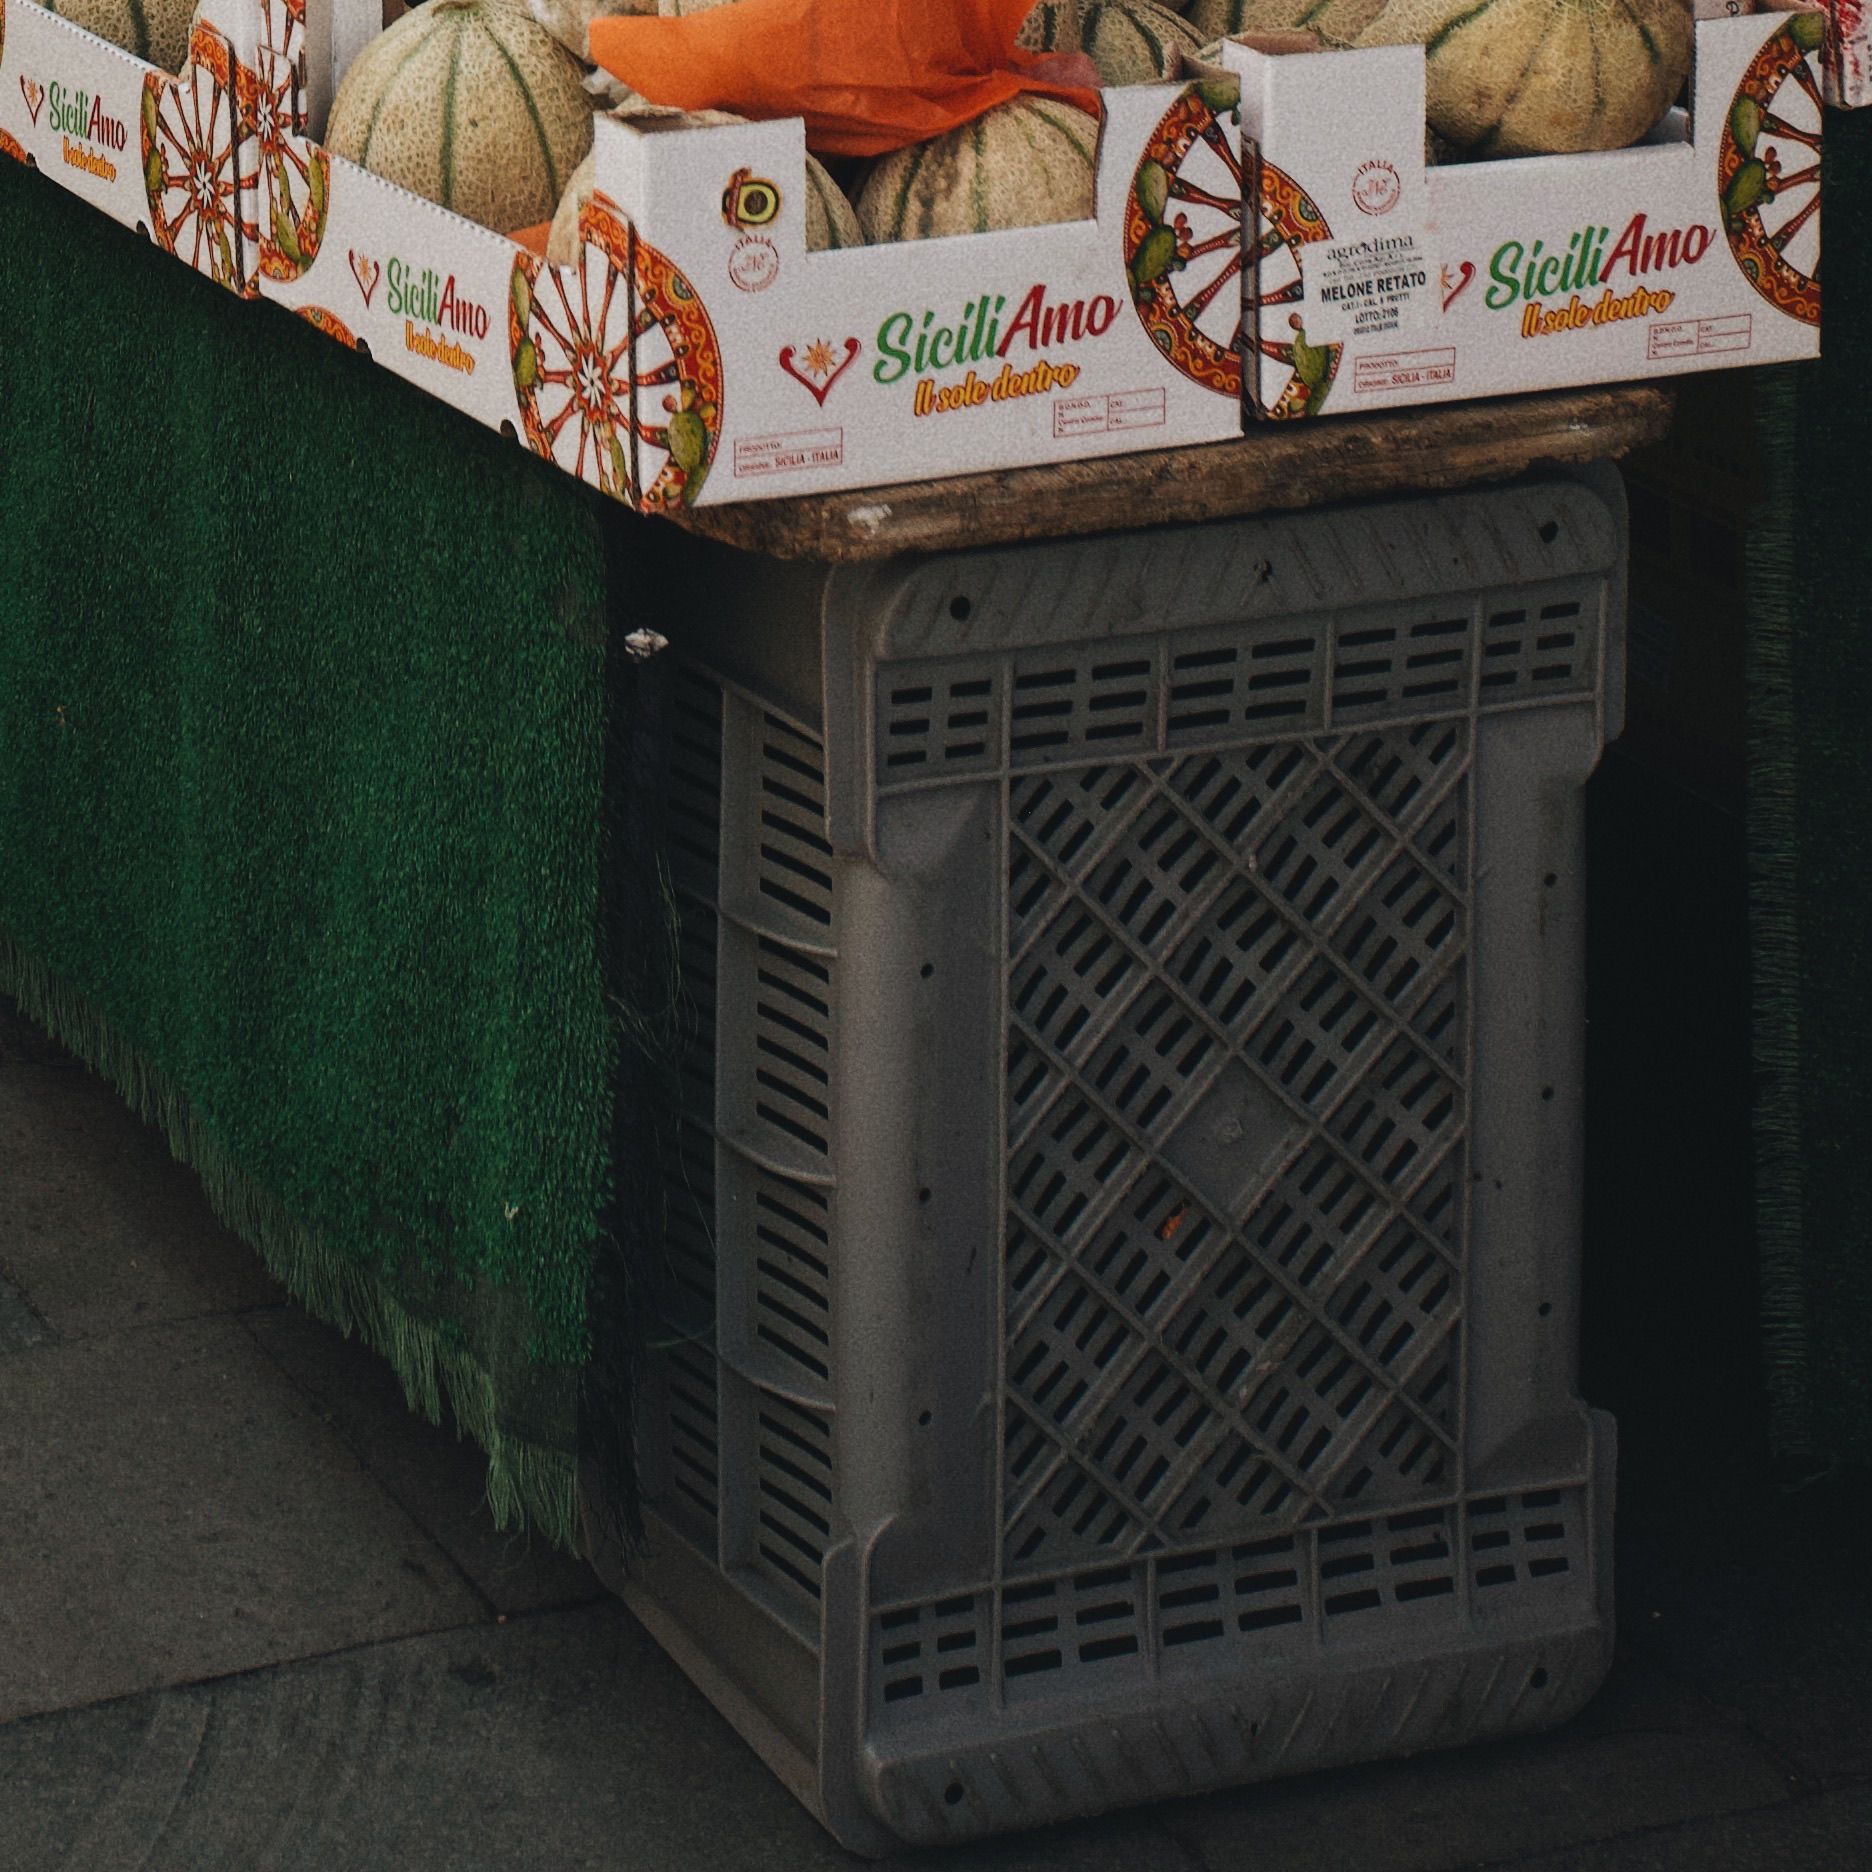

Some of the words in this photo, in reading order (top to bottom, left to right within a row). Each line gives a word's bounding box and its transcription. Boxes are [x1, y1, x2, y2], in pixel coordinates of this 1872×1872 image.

[48, 80, 127, 152] SiciliAmo
[91, 149, 117, 183] dentro
[1321, 280, 1373, 303] MELONE
[1377, 271, 1426, 293] RETATO
[1484, 213, 1716, 311] SiciliAmo
[386, 257, 491, 339] SiciliAmo
[1521, 303, 1537, 338] Il
[1537, 294, 1591, 336] sole
[1592, 287, 1674, 326] dentro
[415, 324, 440, 360] sole
[440, 335, 474, 376] dentro
[873, 283, 1124, 384] SiciliAmo
[914, 378, 935, 417] Il
[936, 370, 990, 413] sole
[991, 359, 1081, 402] dentro
[1392, 372, 1420, 385] SICILIA
[1427, 368, 1451, 381] ITALIA
[775, 454, 806, 468] SICILIA
[812, 448, 839, 462] ITALIA
